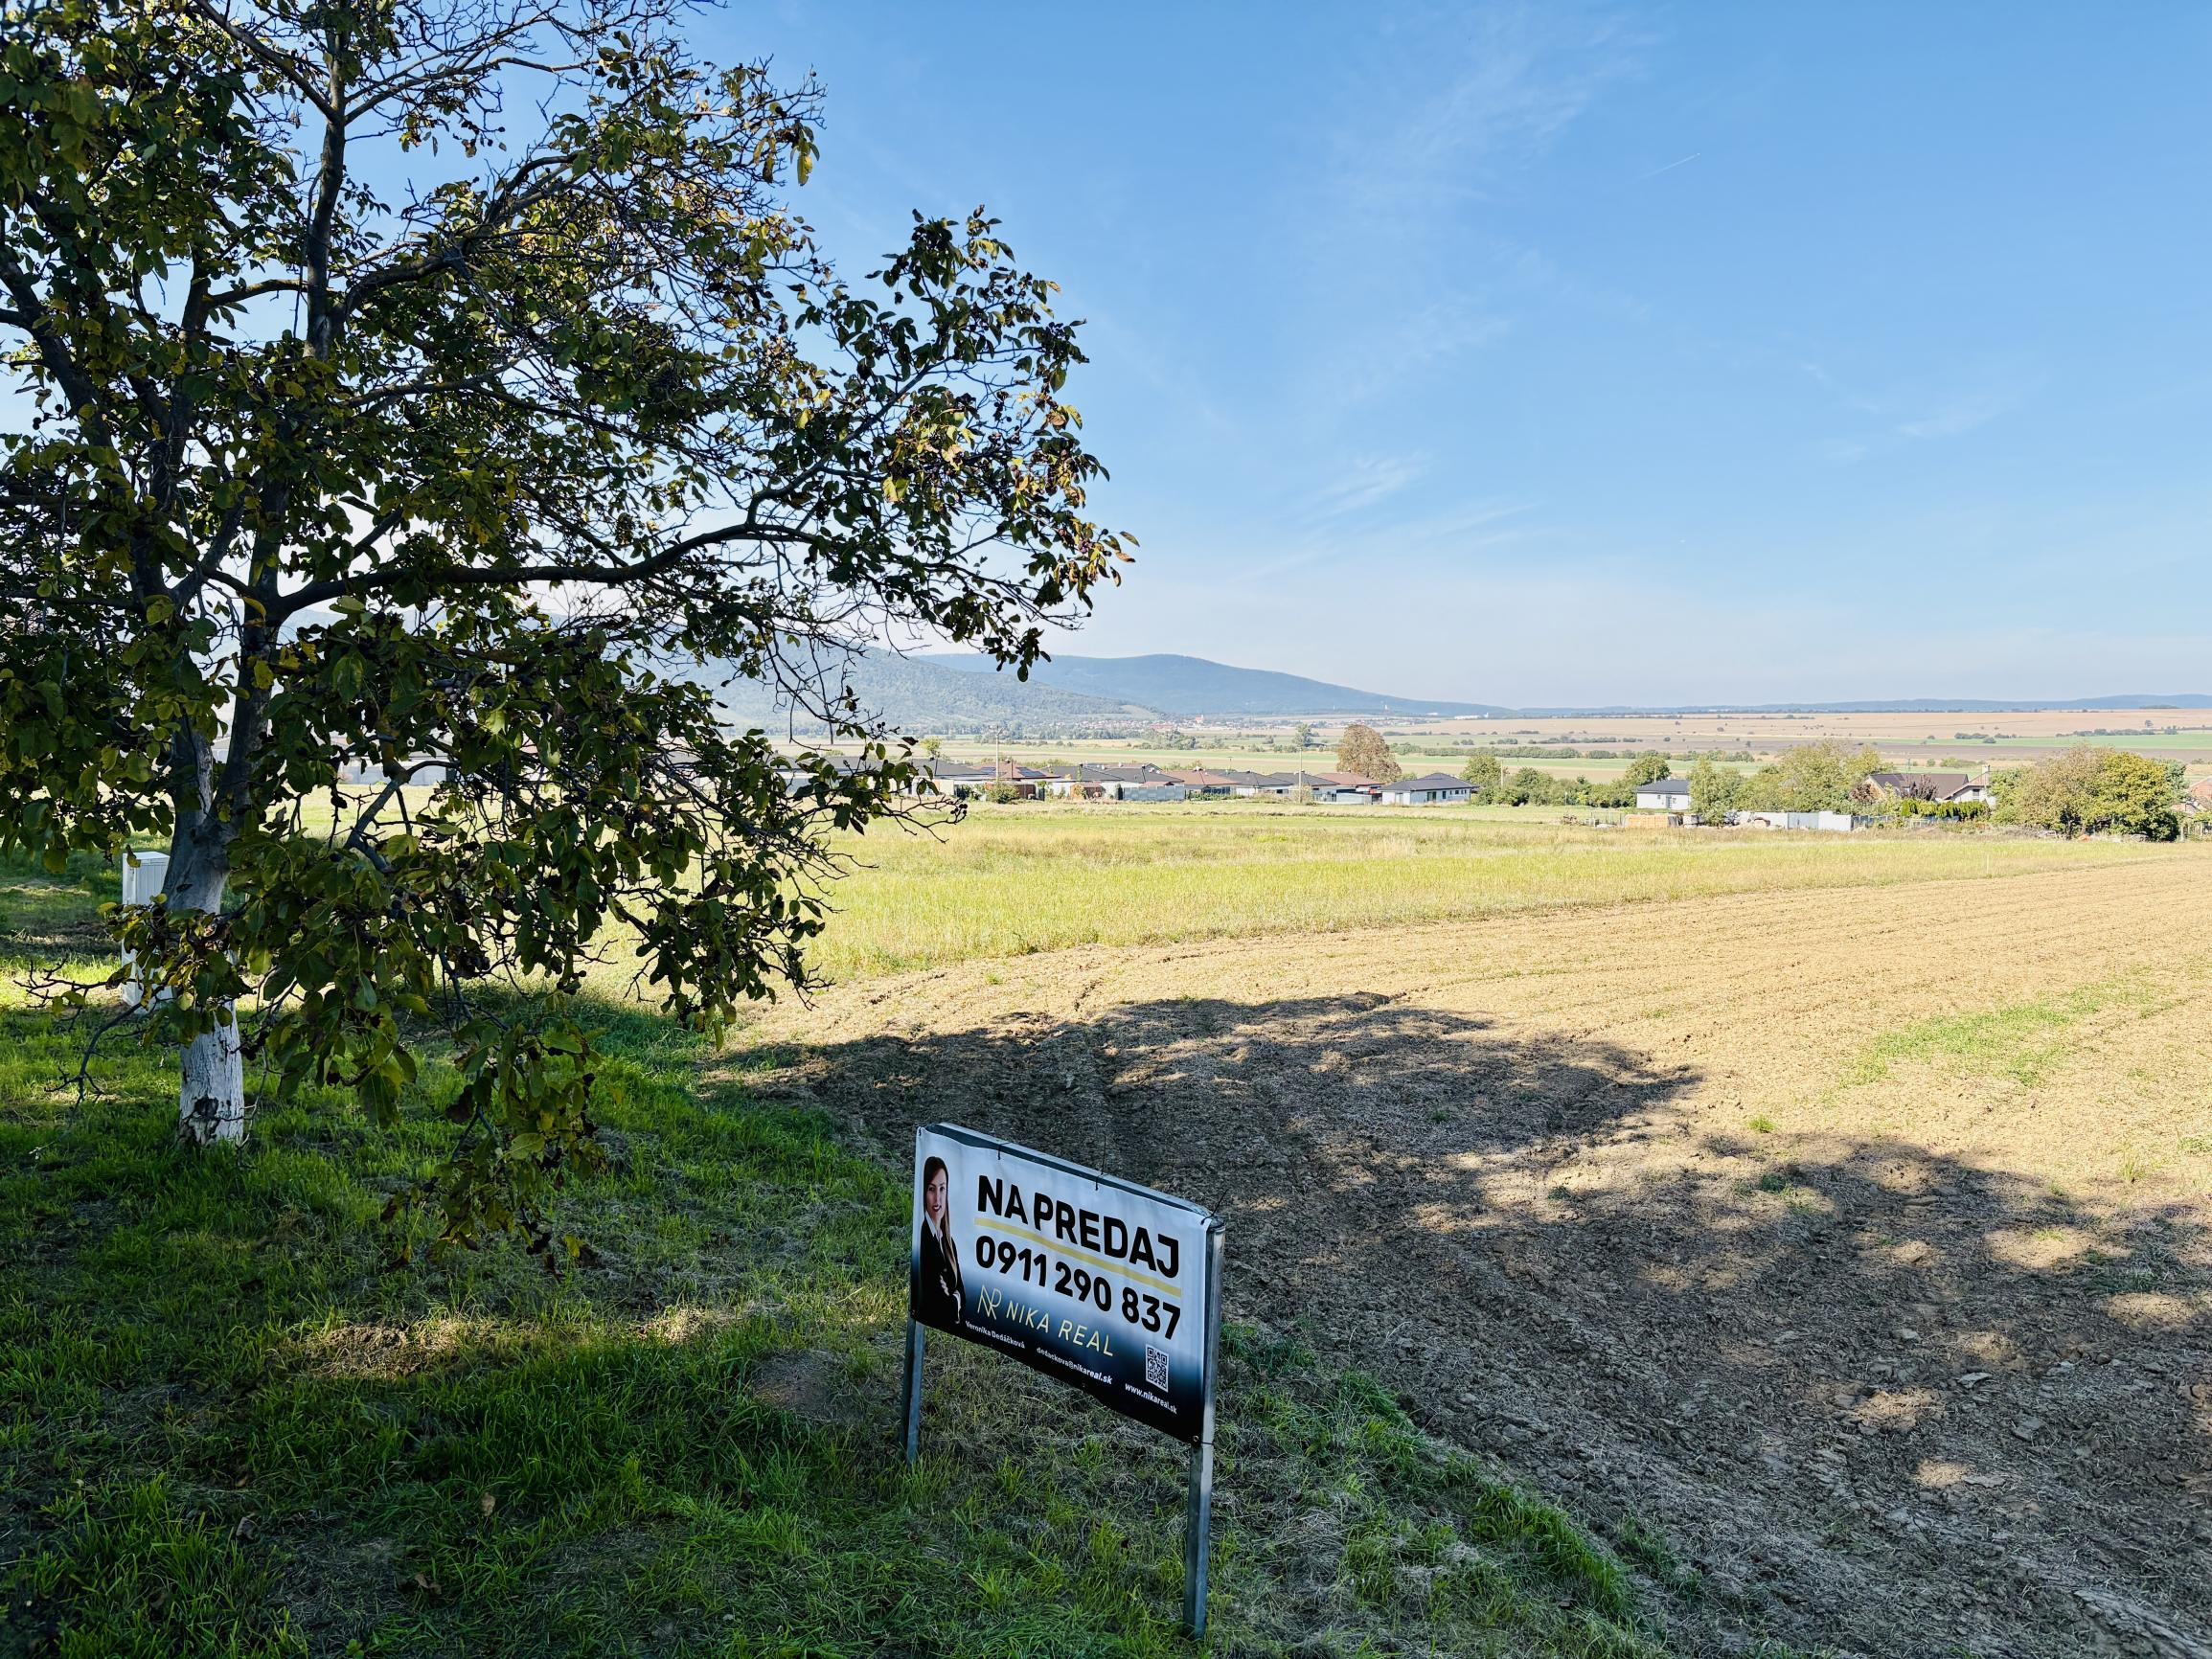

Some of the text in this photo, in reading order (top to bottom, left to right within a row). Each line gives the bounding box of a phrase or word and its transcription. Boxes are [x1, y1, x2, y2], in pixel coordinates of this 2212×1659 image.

[977, 1175, 1179, 1279] NA PREDAJ
[976, 1236, 1181, 1340] 0911 290 837
[965, 1320, 992, 1337] Veronika
[1006, 1300, 1050, 1332] NIKA
[1058, 1320, 1113, 1356] REAL
[1125, 1383, 1177, 1415] www.nikareal.sk
